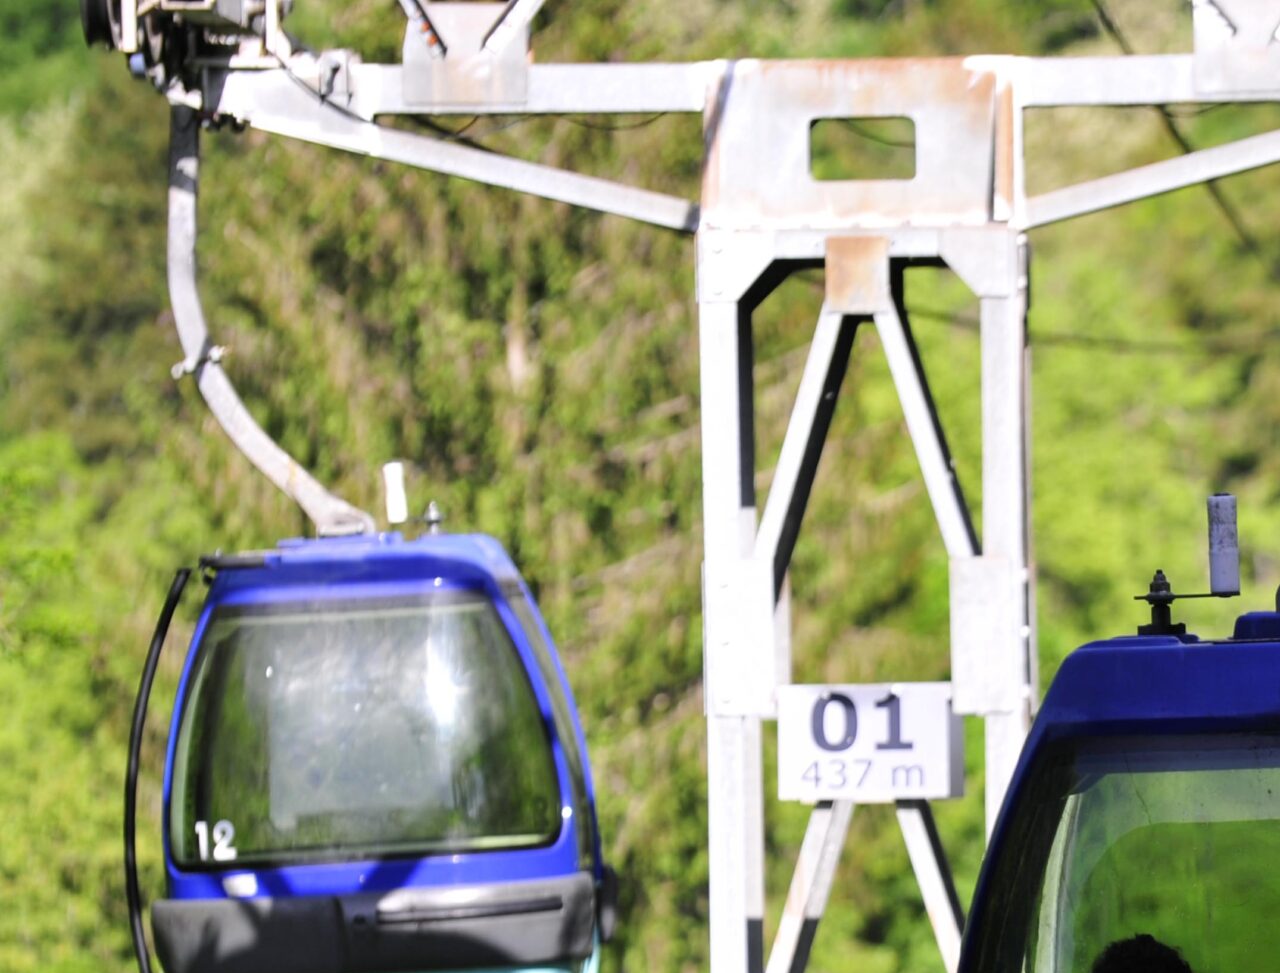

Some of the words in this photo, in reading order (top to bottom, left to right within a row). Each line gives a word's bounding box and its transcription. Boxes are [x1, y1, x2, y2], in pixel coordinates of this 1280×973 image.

[810, 691, 914, 752] 01
[801, 759, 873, 789] 437
[891, 763, 925, 788] m
[194, 819, 238, 862] 12
